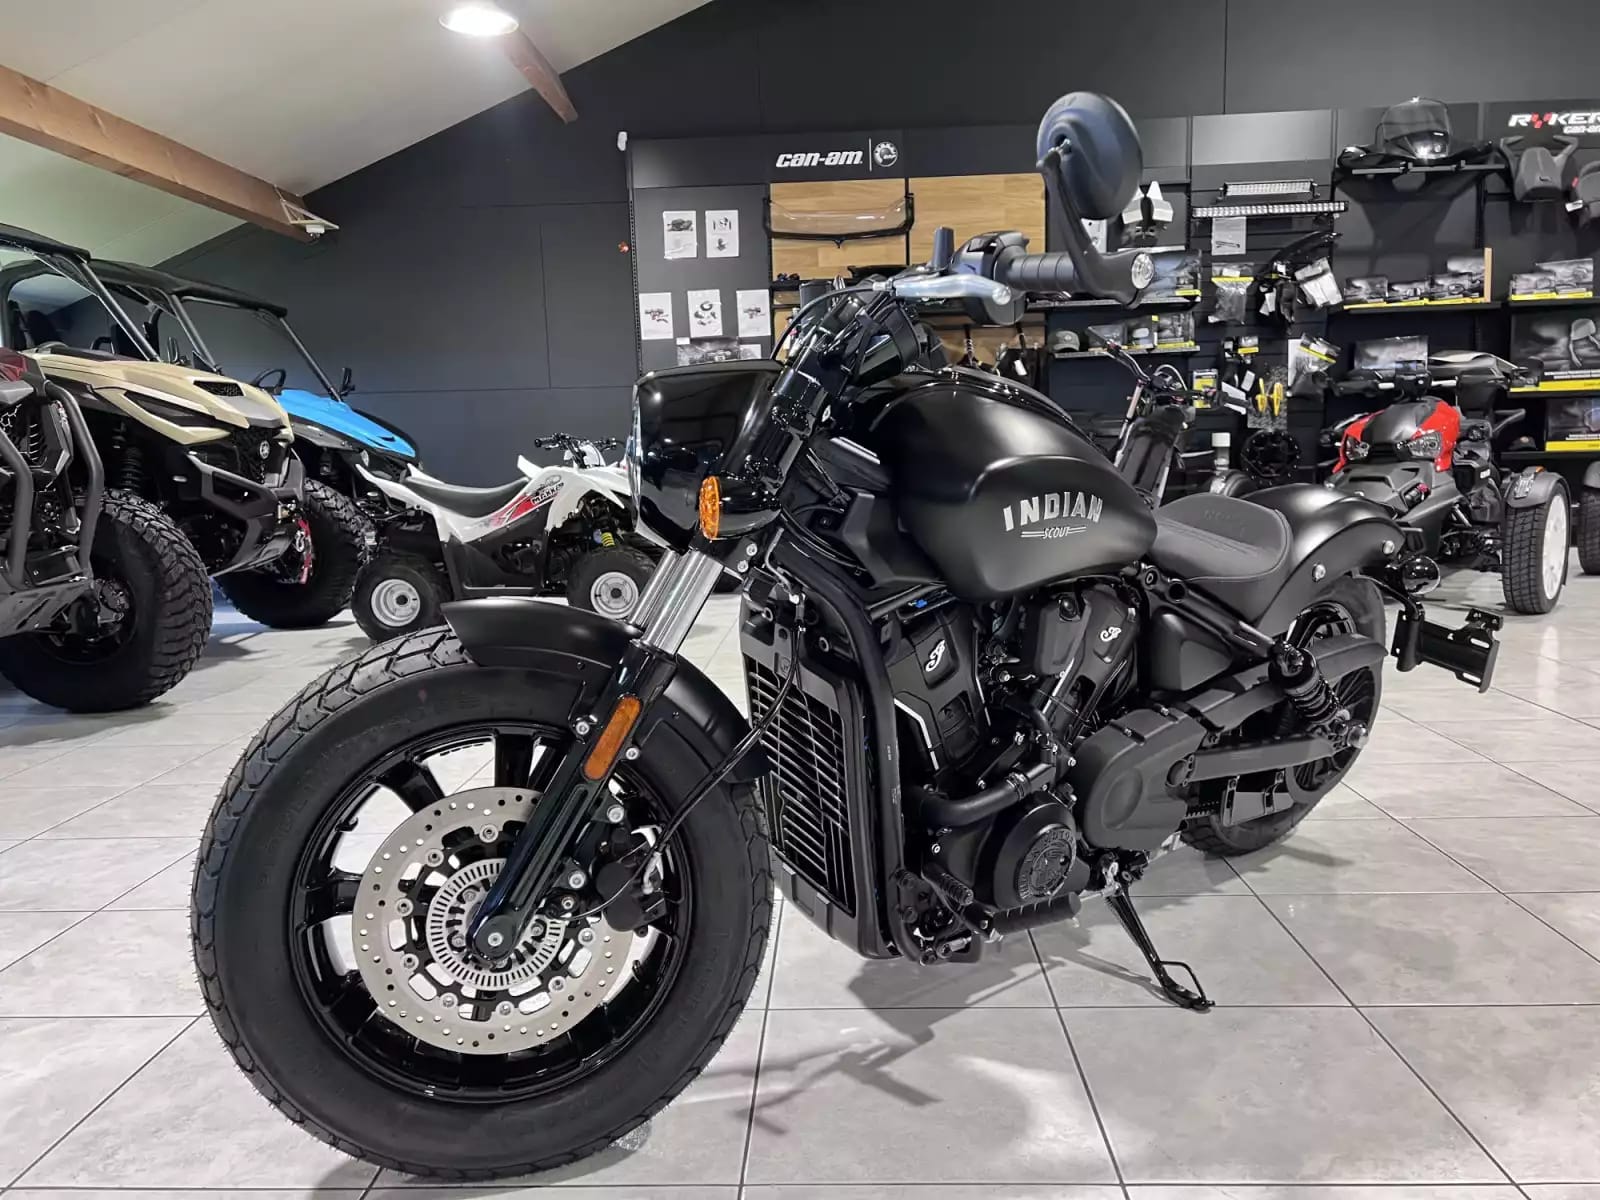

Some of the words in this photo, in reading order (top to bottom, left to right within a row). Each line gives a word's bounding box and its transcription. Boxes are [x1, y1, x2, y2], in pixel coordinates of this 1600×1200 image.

[775, 150, 864, 168] can-am
[1003, 491, 1103, 532] INDIAN
[1043, 526, 1071, 540] SCOUT
